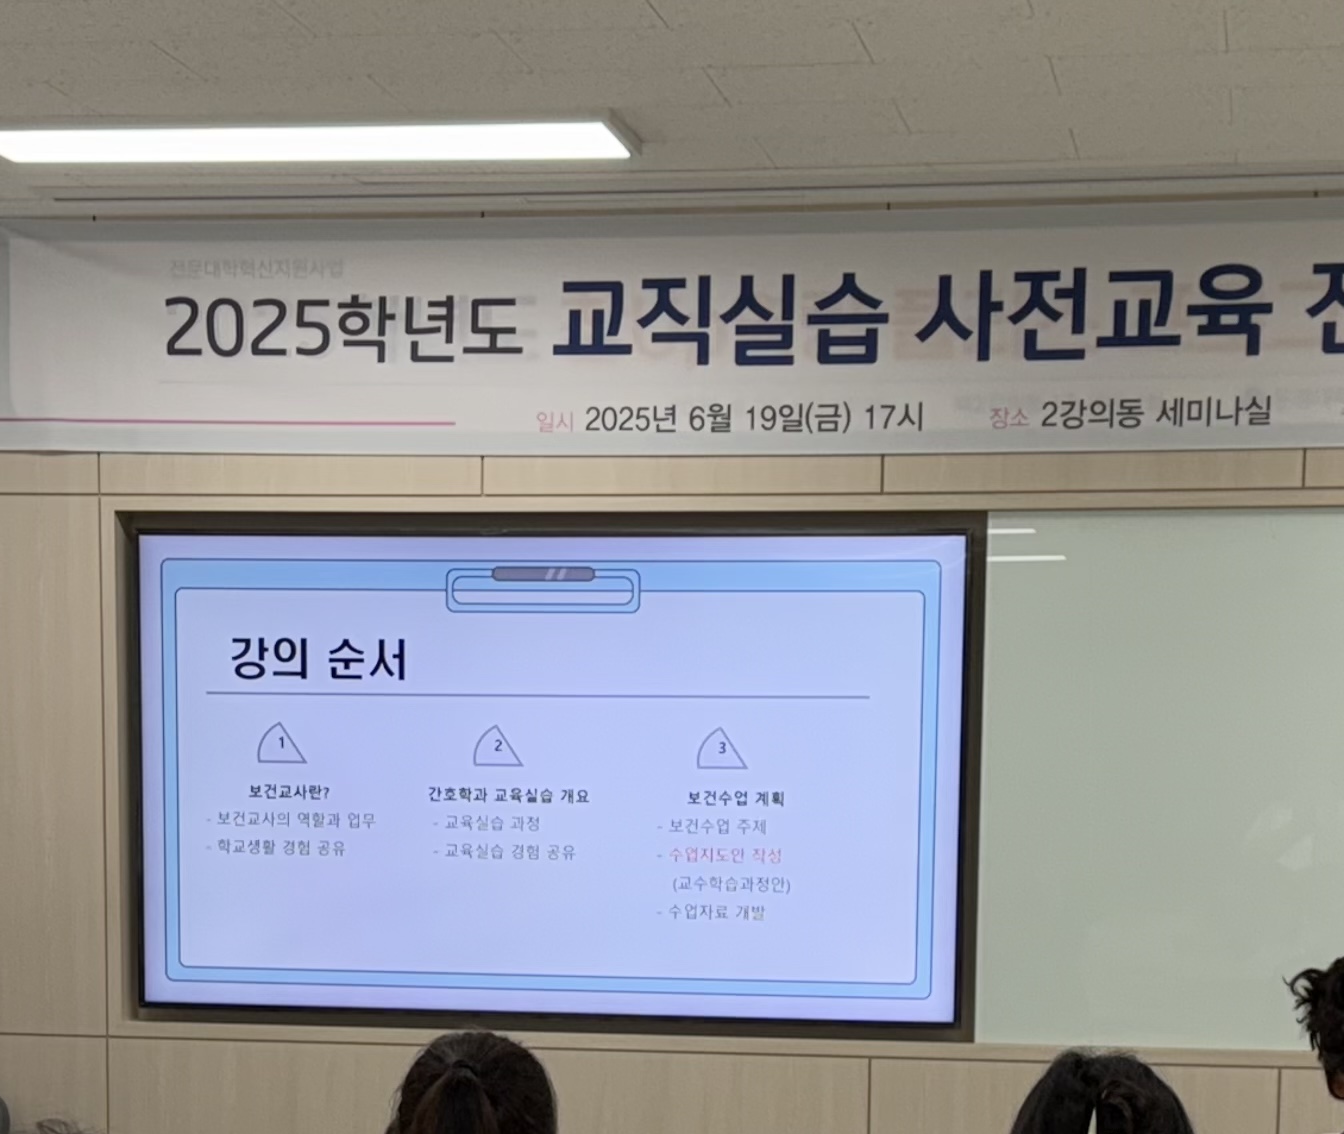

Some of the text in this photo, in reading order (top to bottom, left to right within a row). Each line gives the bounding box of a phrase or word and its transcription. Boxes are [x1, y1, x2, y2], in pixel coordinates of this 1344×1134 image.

[169, 258, 345, 280] 전문대학혁신지원사업
[164, 293, 525, 366] 2025학년도
[552, 272, 890, 367] 교직실습
[914, 262, 1274, 363] 사전교육
[535, 410, 575, 433] 일시
[584, 404, 678, 434] 2025년
[688, 402, 733, 434] 6월
[745, 400, 853, 435] 19일(금)
[864, 401, 924, 432] 17시
[989, 405, 1030, 430] 장소
[1040, 398, 1145, 430] 2강의동
[1155, 395, 1273, 428] 세미나실
[230, 636, 407, 682] 강의 순서
[277, 736, 285, 749] 1
[493, 739, 503, 752] 2
[717, 741, 727, 755] 3
[248, 783, 331, 801] 보건교사란?
[427, 786, 591, 805] 간호학과 교육실습 개요
[686, 790, 786, 808] 보건수업 계획
[217, 810, 377, 830] 보건교사의 역할과 업무
[444, 815, 541, 833] 교육실습 과정
[668, 818, 768, 836] 보건수업 주제
[217, 838, 346, 858] 학교생활 경험 공유
[444, 842, 576, 861] 교육실습 경험 공유
[668, 846, 783, 866] 수업지도안 작성
[672, 875, 791, 895] (교수학습과정안)
[668, 903, 766, 921] 수업자료 개발
